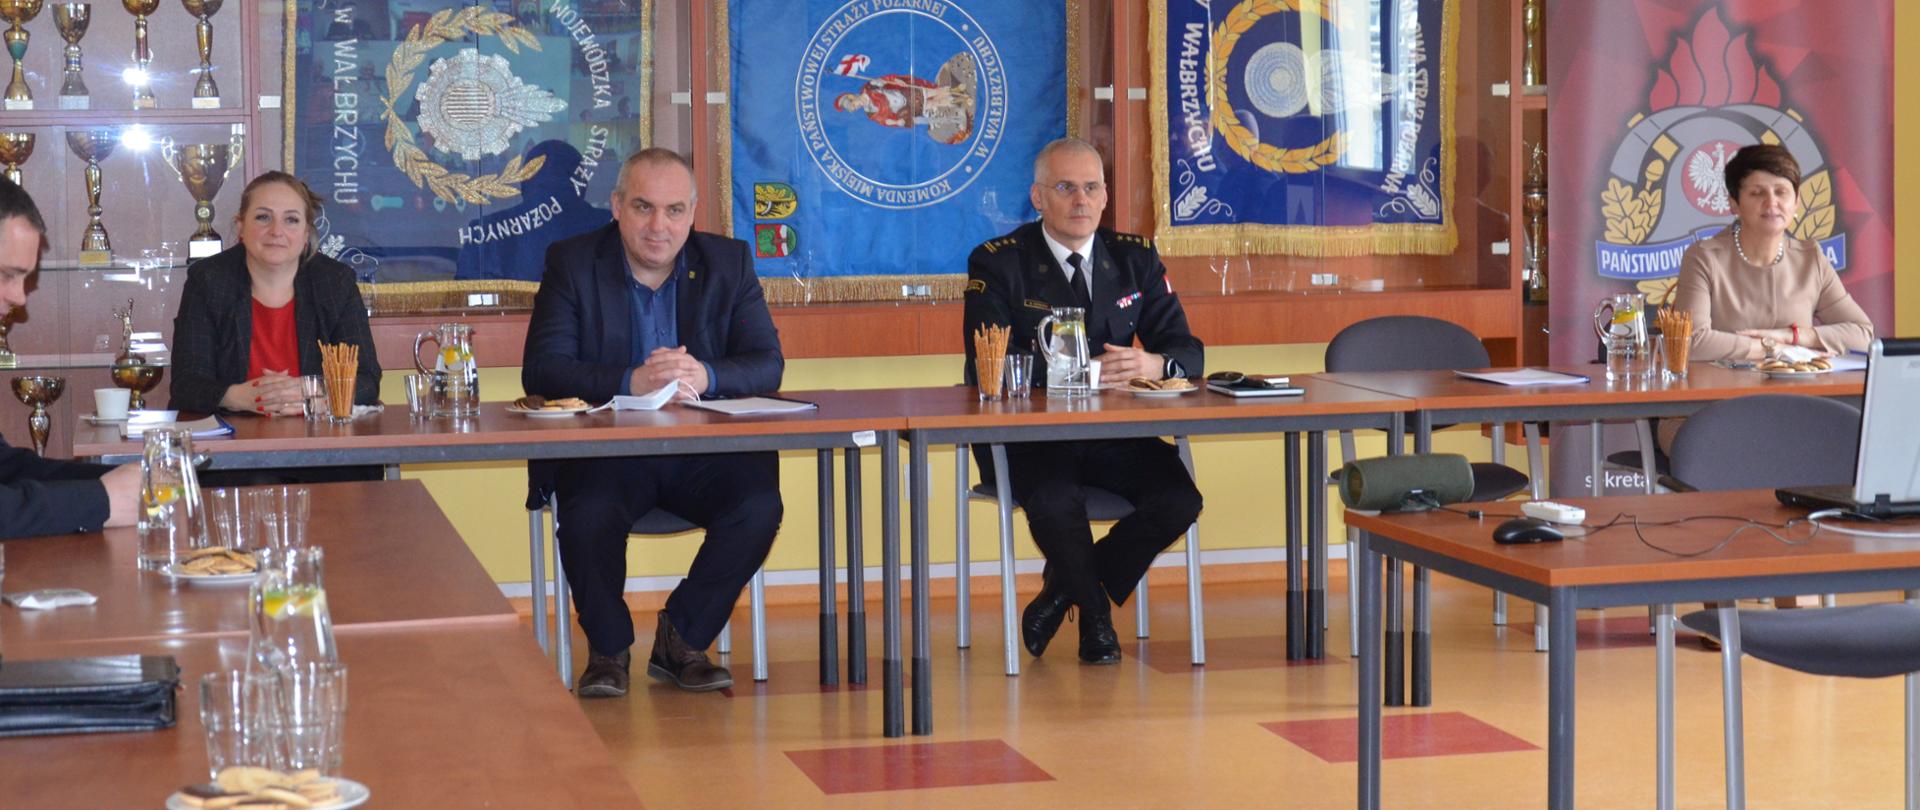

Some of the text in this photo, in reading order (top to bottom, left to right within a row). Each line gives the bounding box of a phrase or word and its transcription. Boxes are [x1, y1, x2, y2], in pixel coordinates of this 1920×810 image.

[820, 3, 869, 46] STRAŻY
[334, 7, 358, 204] W WAŁBRZYCHU
[458, 0, 612, 244] WOJEWÓDZKA STRAŻY POŻARNYCH
[801, 43, 827, 151] PAŃSTWOWEJ
[972, 36, 1003, 159] W WAŁBRZYCHU
[1179, 22, 1216, 173] WAŁBRZYCHU
[820, 151, 875, 197] MIEJSKA
[877, 179, 952, 204] KOMENDA
[1601, 245, 1690, 273] PAŃSTWOW
